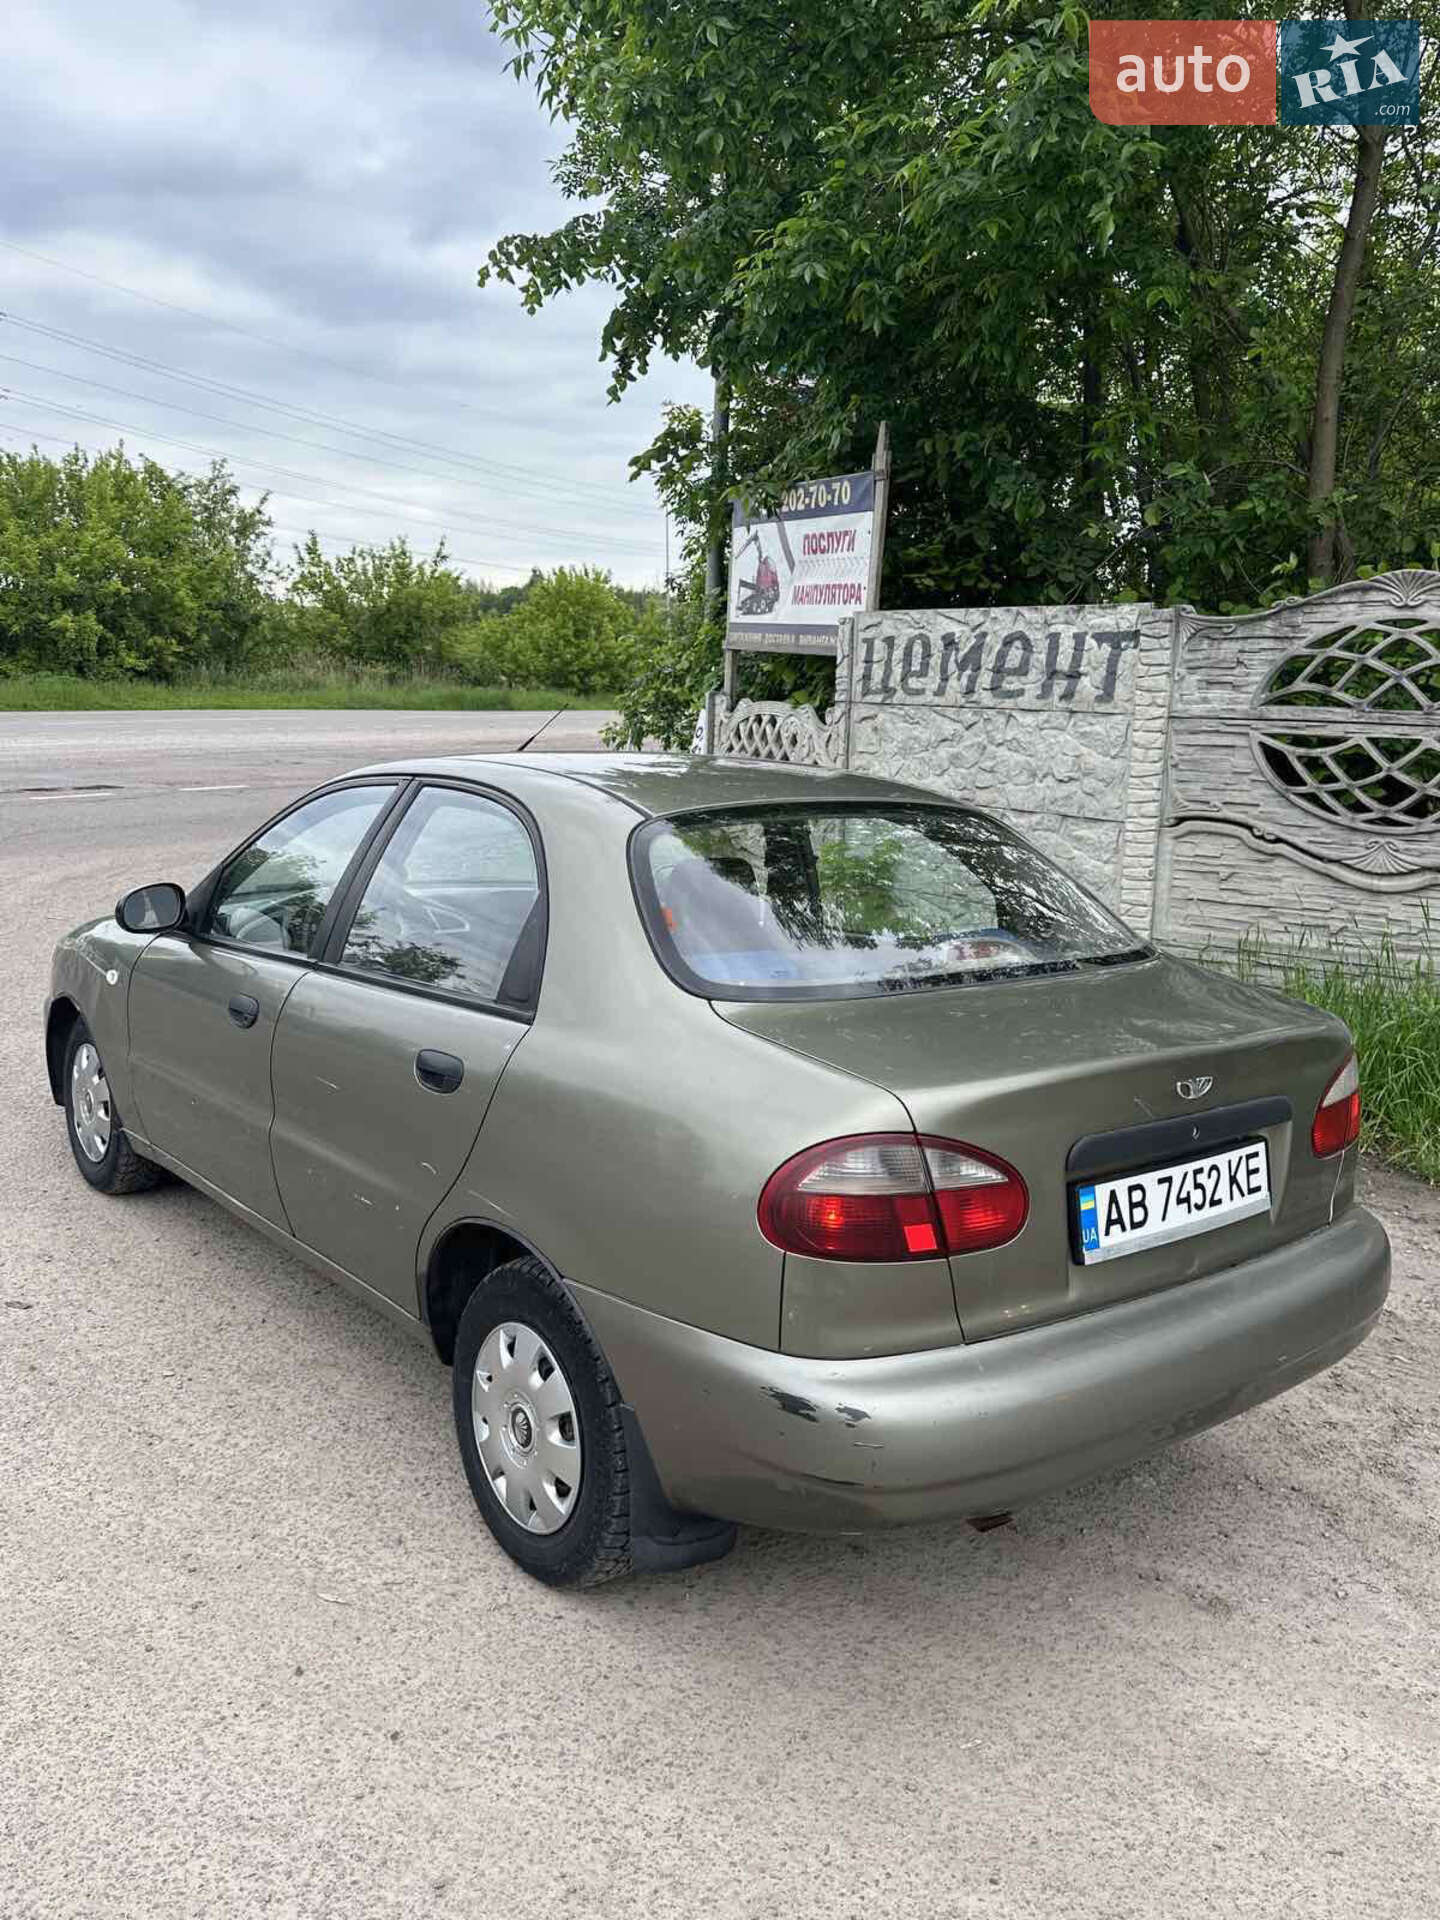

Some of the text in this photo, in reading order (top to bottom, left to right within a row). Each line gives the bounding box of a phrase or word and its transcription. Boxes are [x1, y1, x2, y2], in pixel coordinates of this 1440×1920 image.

[803, 529, 857, 556] ПОСЛУГИ
[1104, 1151, 1262, 1237] AB 7452 KE
[1082, 1228, 1098, 1243] UA
